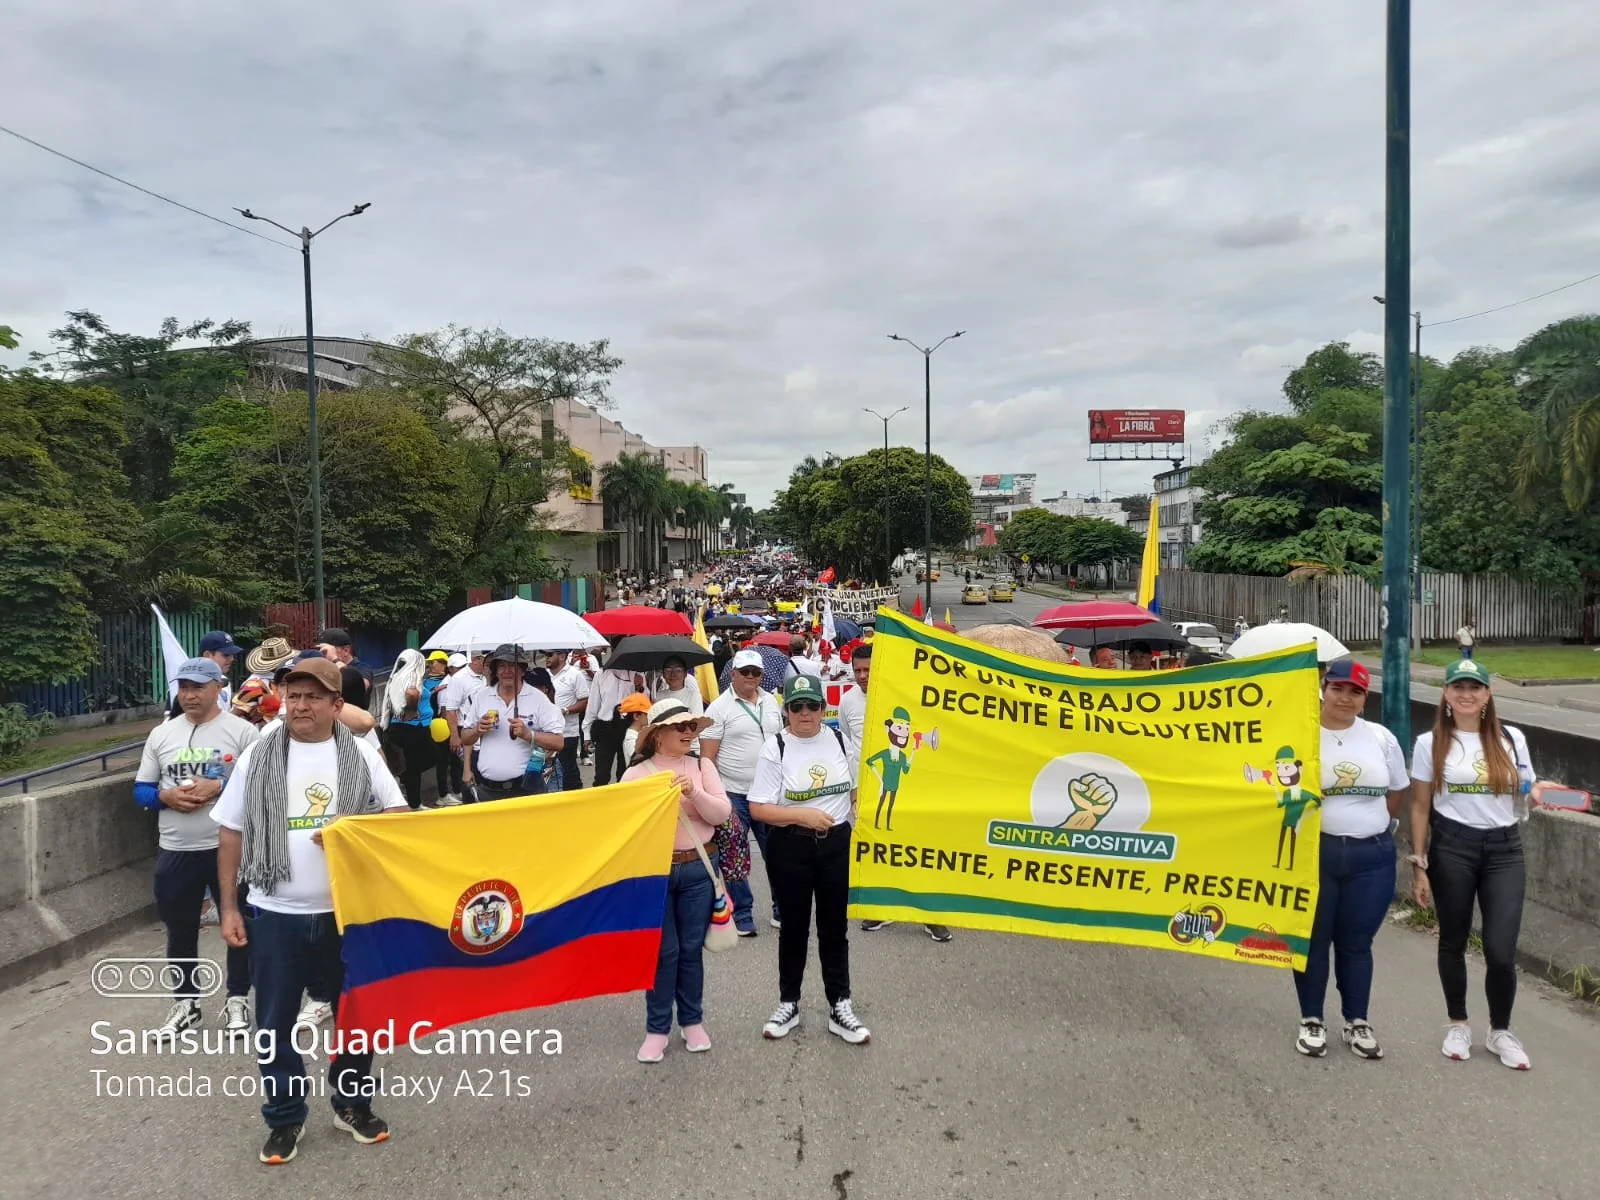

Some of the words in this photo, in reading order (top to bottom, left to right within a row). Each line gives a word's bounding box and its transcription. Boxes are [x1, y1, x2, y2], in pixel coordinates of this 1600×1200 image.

[1120, 421, 1130, 433] LA
[1131, 420, 1155, 433] FIBRA
[913, 648, 967, 679] POR
[977, 670, 1016, 689] UN
[1024, 682, 1161, 713] TRABAJO
[1172, 682, 1272, 712] JUSTO,
[921, 685, 1048, 727] DECENTE
[1059, 707, 1073, 730] E
[1085, 713, 1262, 743] INCLUYENTE
[992, 826, 1168, 856] SINTRAPOSITIVA
[855, 841, 995, 879] PRESENTE,
[1006, 858, 1152, 894] PRESENTE,
[1164, 873, 1310, 912] PRESENTE
